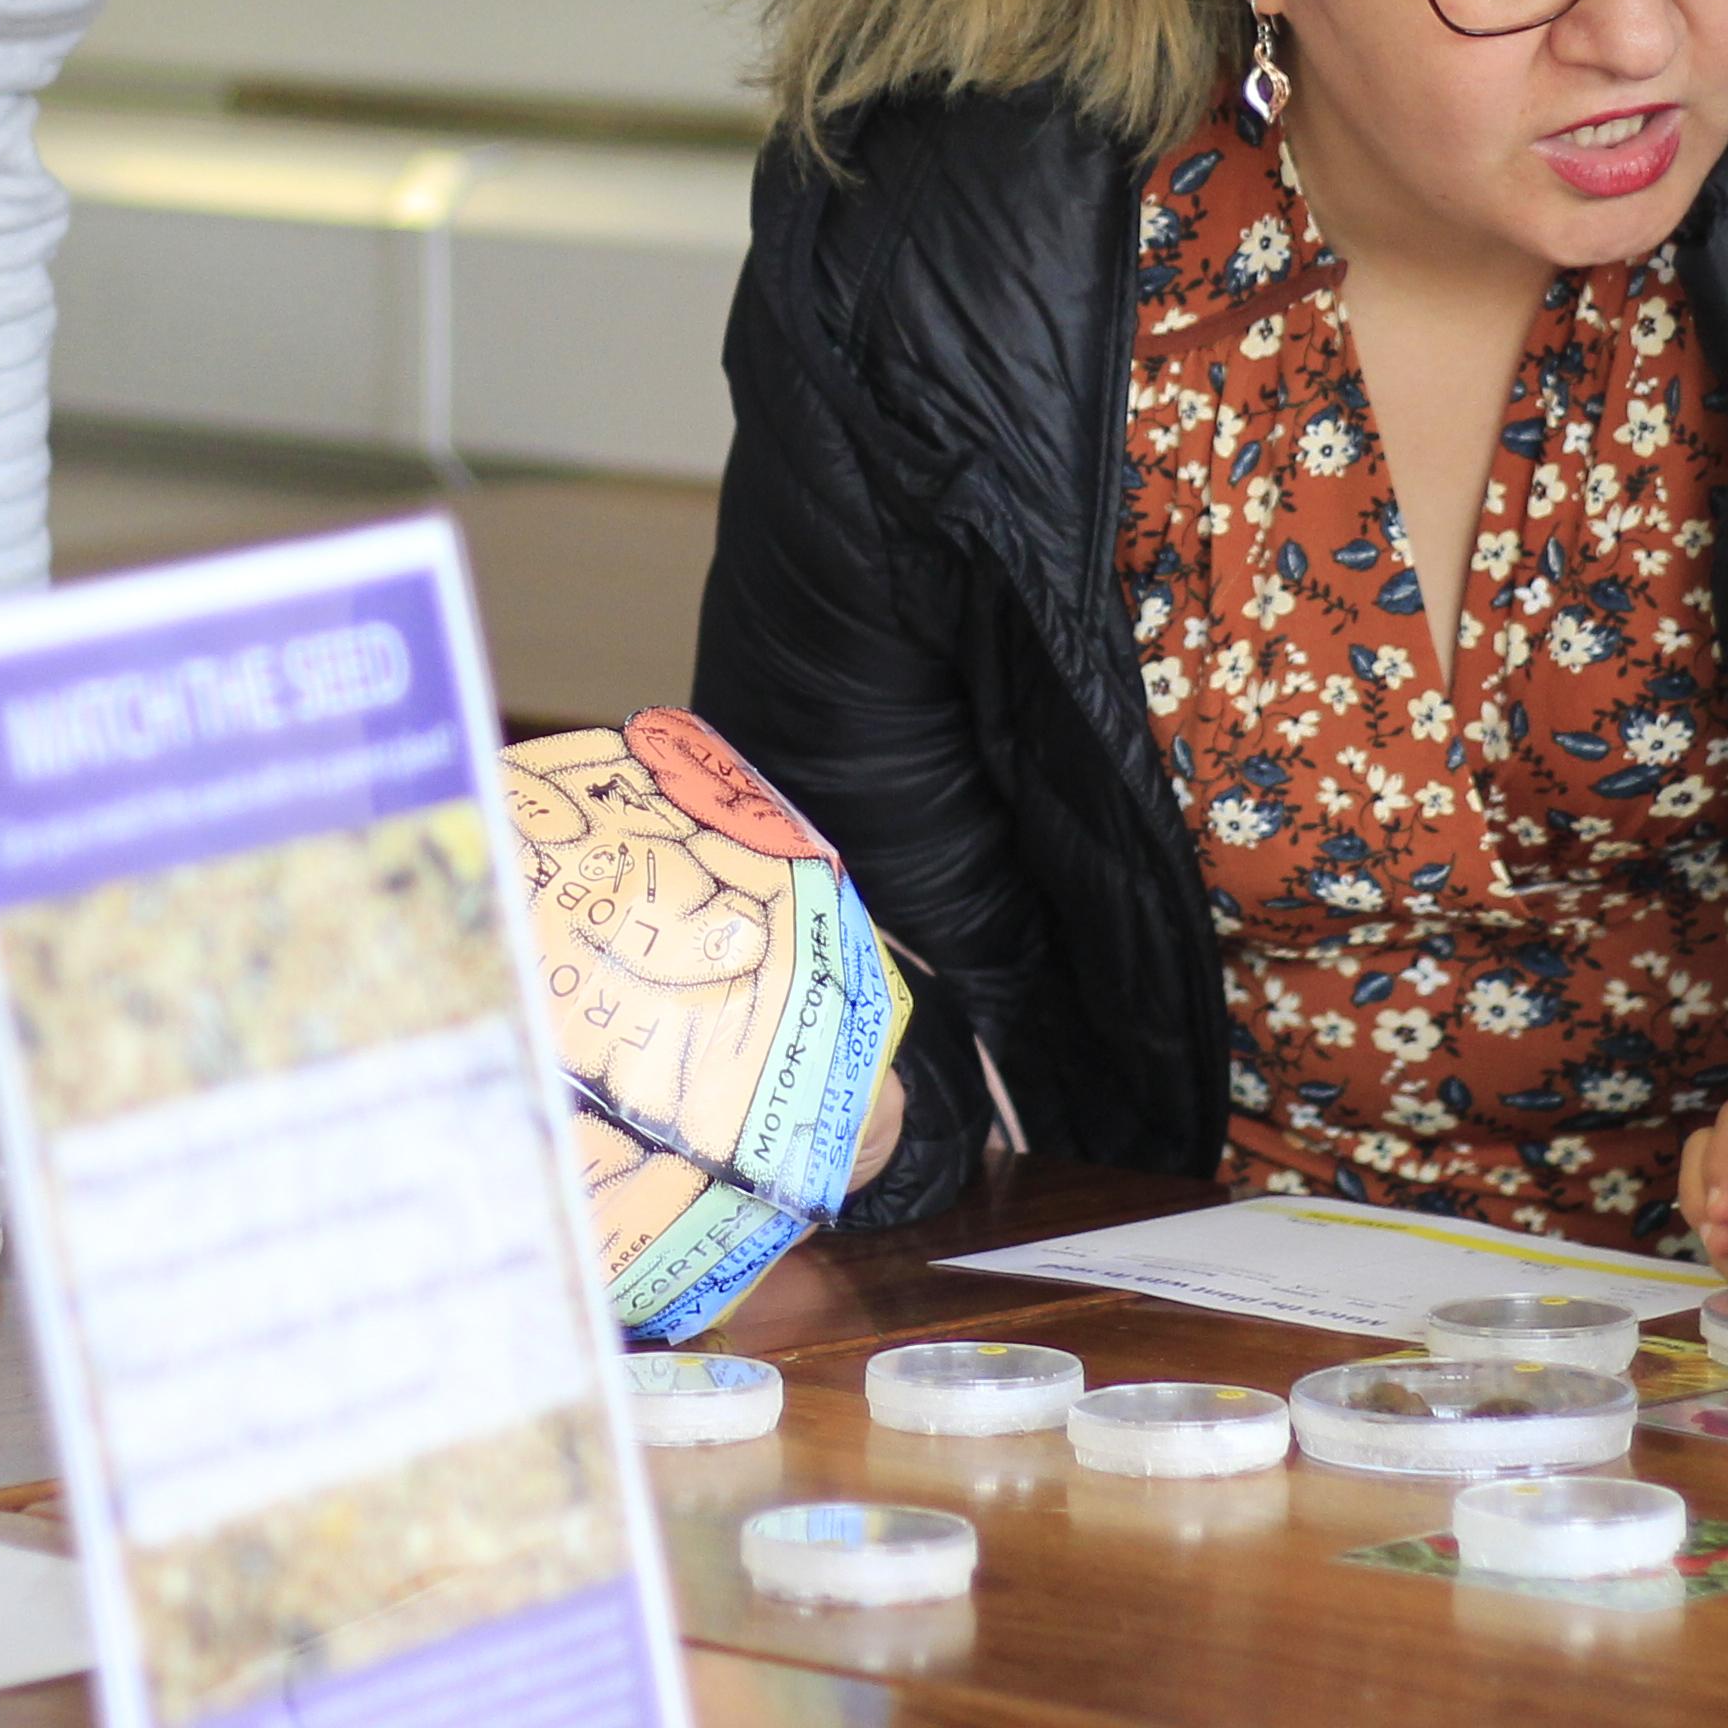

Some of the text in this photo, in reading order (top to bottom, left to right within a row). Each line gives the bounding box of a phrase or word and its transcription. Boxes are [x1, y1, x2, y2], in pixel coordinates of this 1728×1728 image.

[754, 1042, 808, 1162] MOTOR
[799, 908, 829, 1028] CORTEX
[862, 939, 886, 1068] CORTEX
[829, 992, 875, 1172] SENSORY
[610, 1233, 653, 1274] AREA
